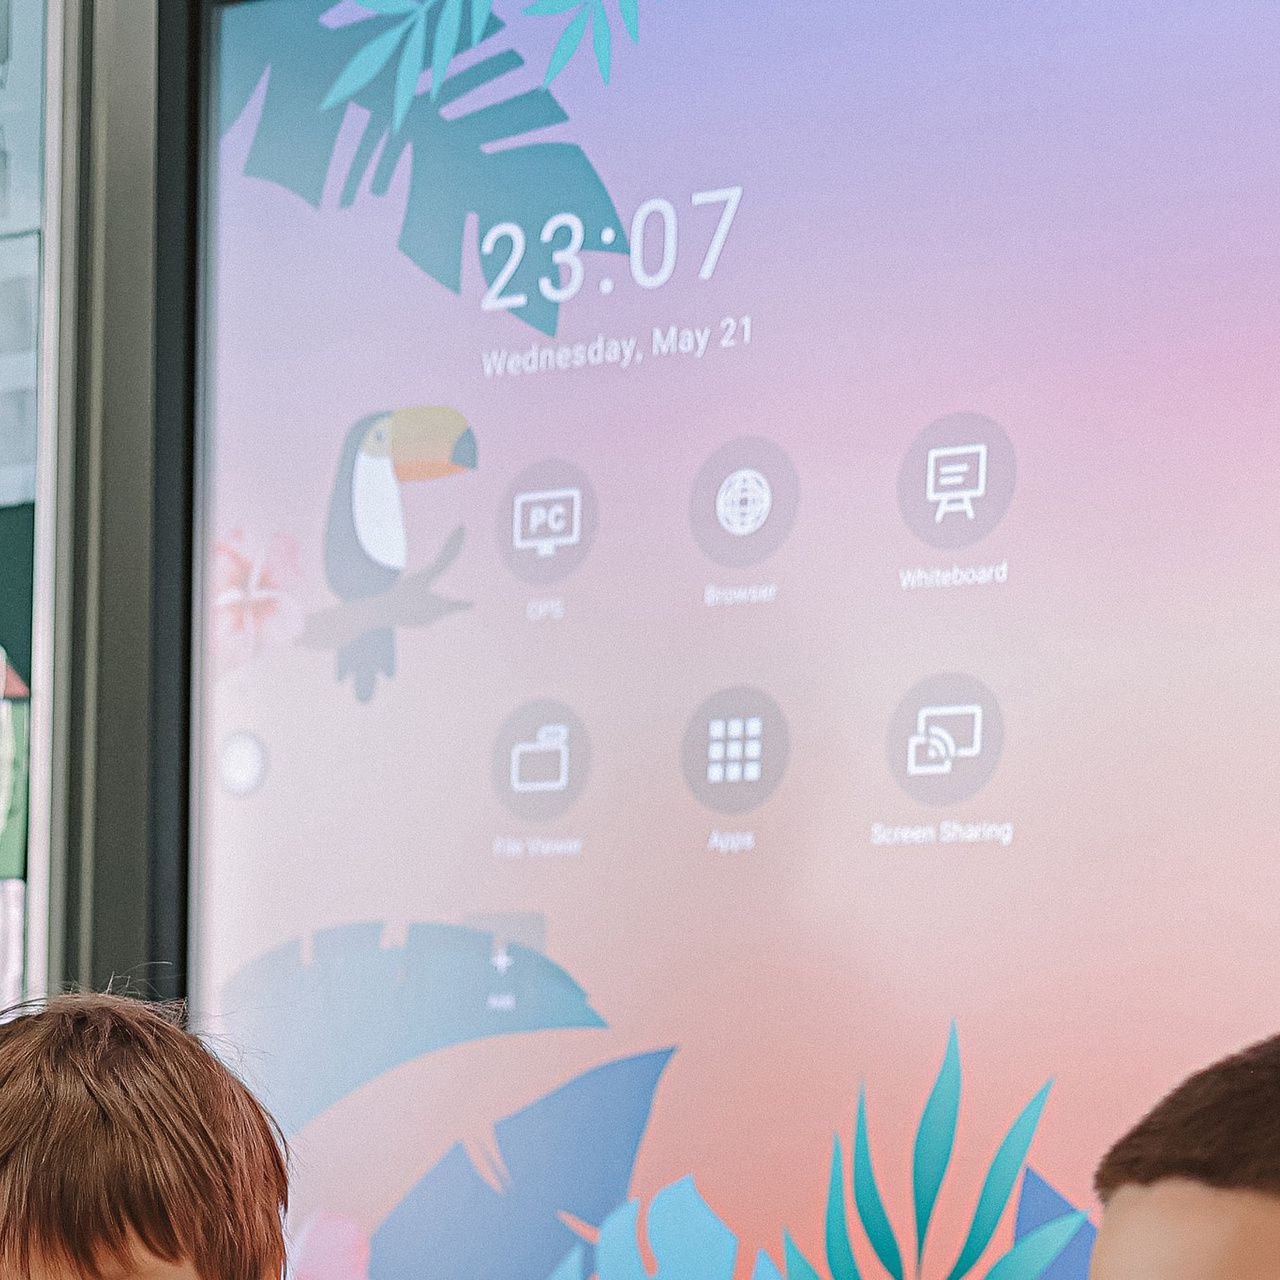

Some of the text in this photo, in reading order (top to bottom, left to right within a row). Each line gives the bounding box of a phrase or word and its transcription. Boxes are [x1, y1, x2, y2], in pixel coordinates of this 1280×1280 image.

[480, 185, 744, 311] 23:07
[481, 315, 754, 378] Wednesday, May 21
[528, 504, 566, 533] PC
[899, 558, 1009, 590] Whiteboard
[703, 583, 778, 607] Browser
[707, 829, 756, 853] Apps
[870, 819, 1014, 847] Screen Sharing
